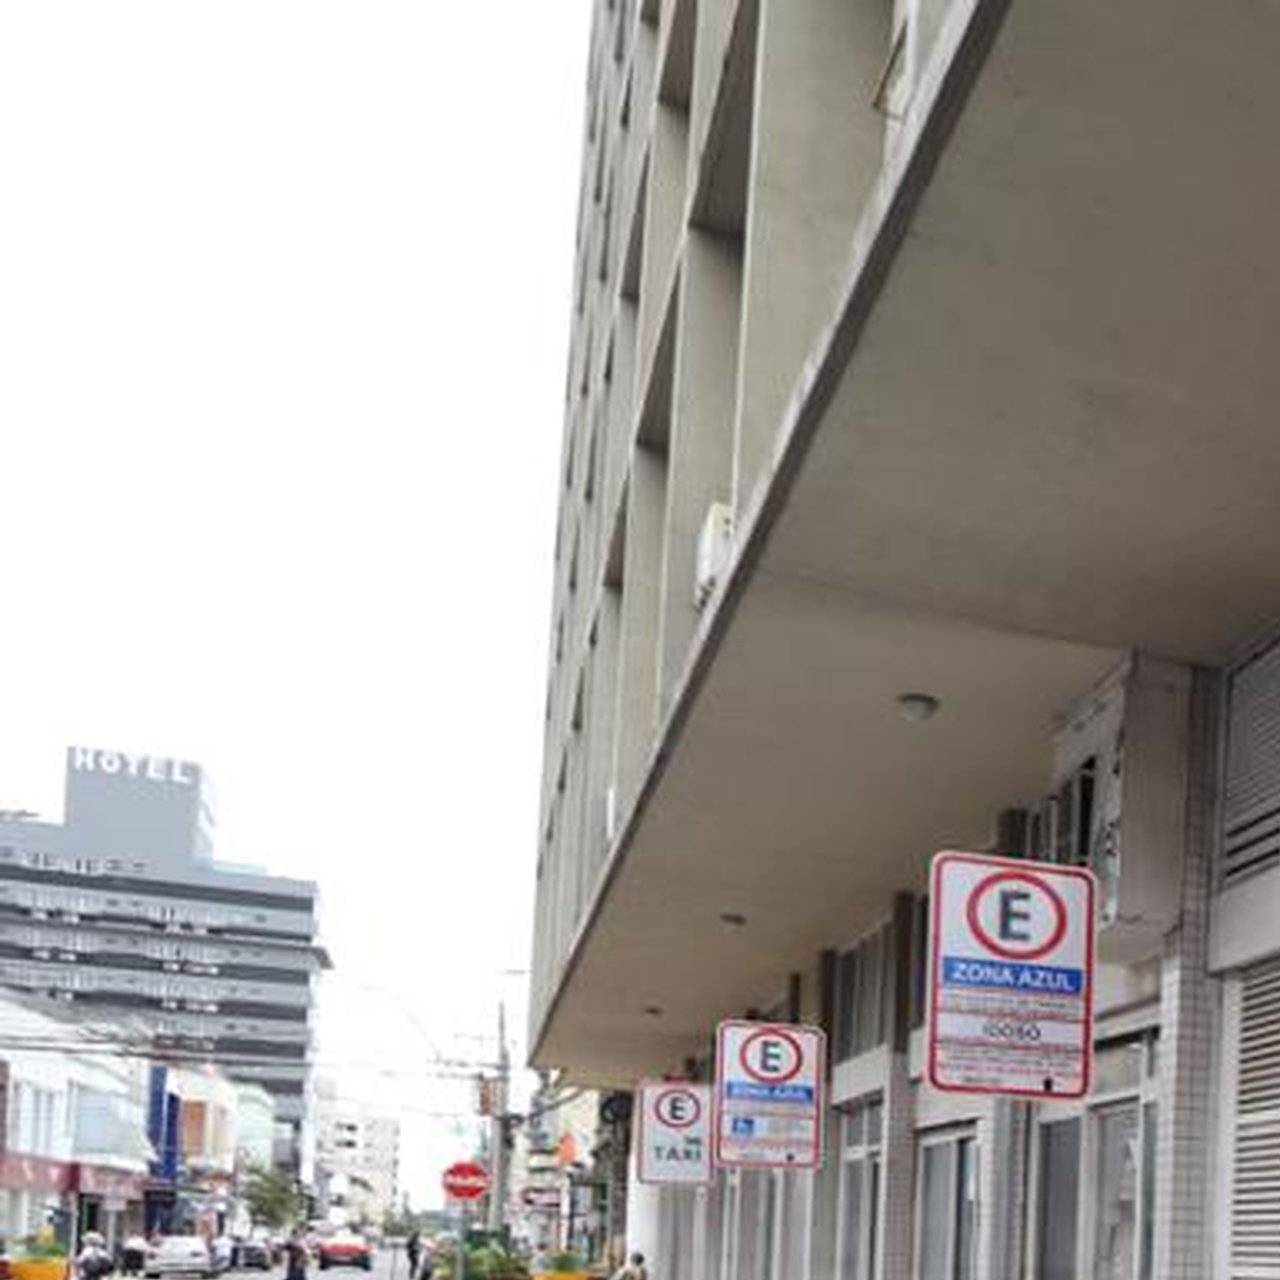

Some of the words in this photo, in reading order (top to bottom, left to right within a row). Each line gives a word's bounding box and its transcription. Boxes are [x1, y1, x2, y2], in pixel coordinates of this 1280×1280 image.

[75, 745, 193, 785] HOTEL
[999, 889, 1031, 941] E
[952, 961, 1014, 986] ZONA
[1016, 967, 1077, 992] AZUL
[760, 1040, 781, 1073] E
[669, 1096, 686, 1121] E
[654, 1145, 702, 1161] TAXI
